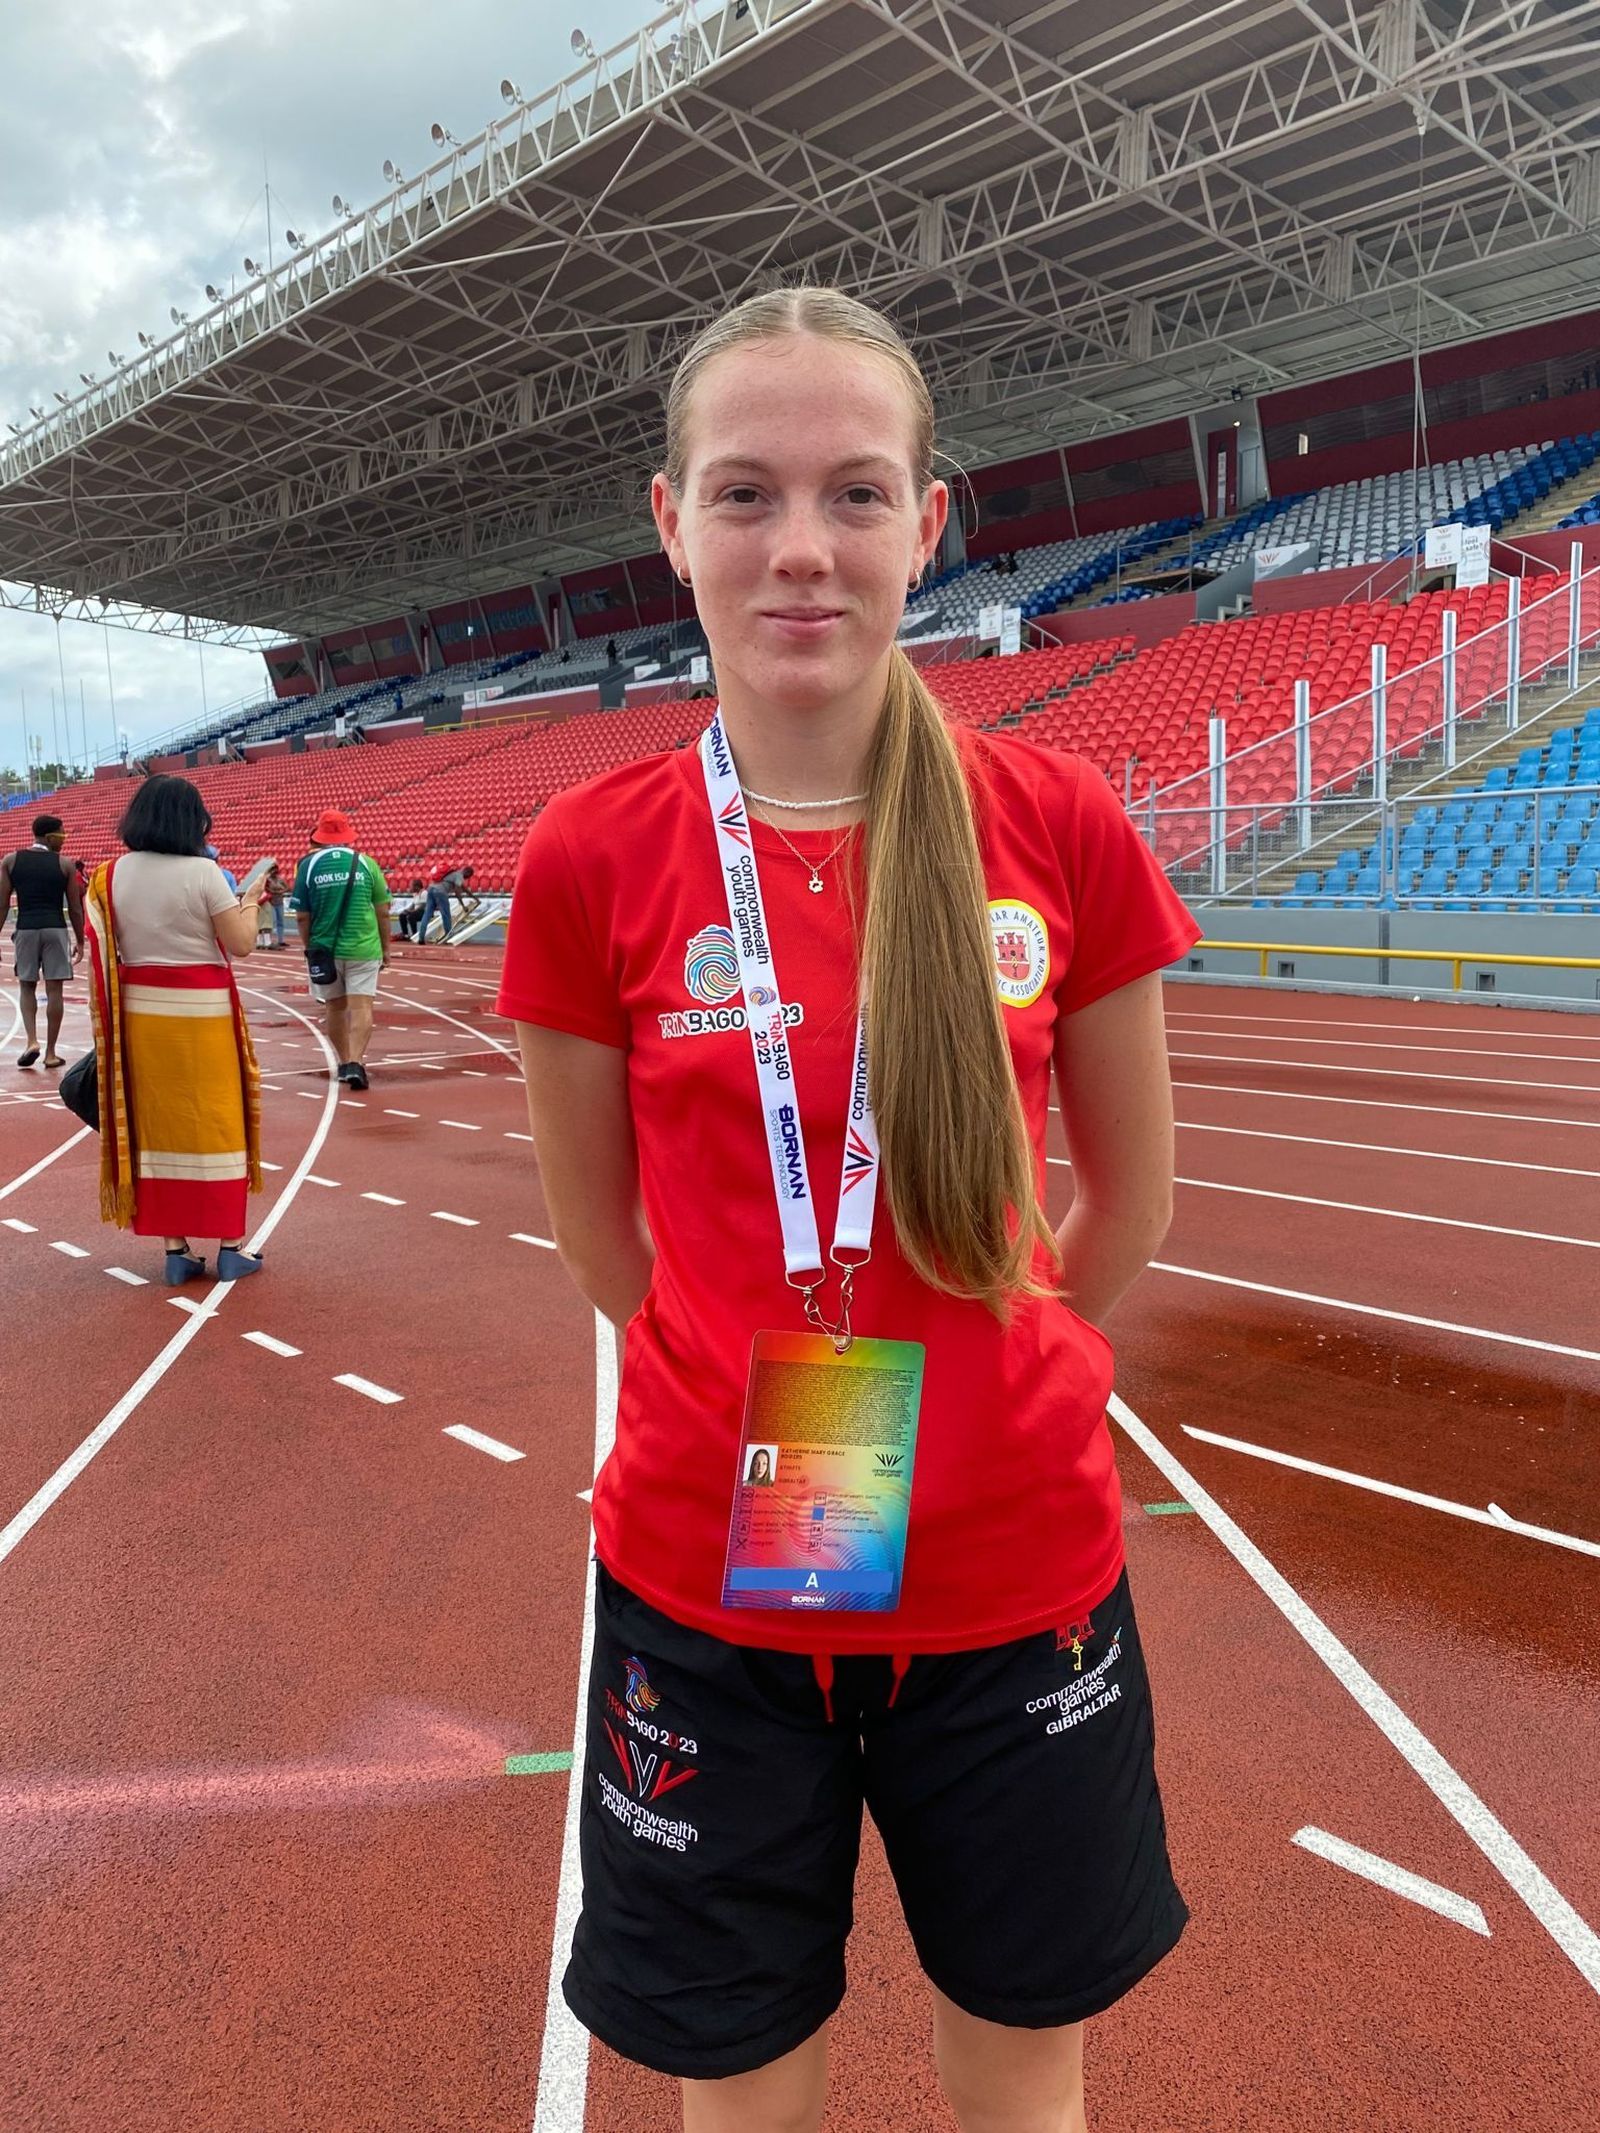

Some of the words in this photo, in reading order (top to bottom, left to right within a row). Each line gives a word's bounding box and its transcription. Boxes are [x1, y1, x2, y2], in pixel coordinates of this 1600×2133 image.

[710, 712, 732, 777] ORNAN
[314, 872, 334, 885] COOK
[334, 871, 365, 881] ISLADS
[726, 865, 747, 905] youth
[740, 855, 769, 964] commonwealth
[733, 907, 754, 958] games
[1013, 911, 1046, 951] AMATEUR
[1009, 958, 1046, 996] ASSOCIATION
[659, 1009, 745, 1037] TRINBAGO
[754, 1031, 772, 1065] 2023
[768, 1010, 791, 1080] TRINBAGO
[769, 1109, 782, 1142] SPORTS
[778, 1103, 807, 1199] BORNAN
[805, 1571, 819, 1588] A
[1025, 1641, 1123, 1714] commonwealth
[1059, 1676, 1107, 1717] games
[1045, 1683, 1123, 1735] GIBRALTAR
[659, 1729, 699, 1755] 2023
[598, 1773, 700, 1843] commonwealth
[601, 1789, 632, 1828] youth
[632, 1817, 687, 1853] games
